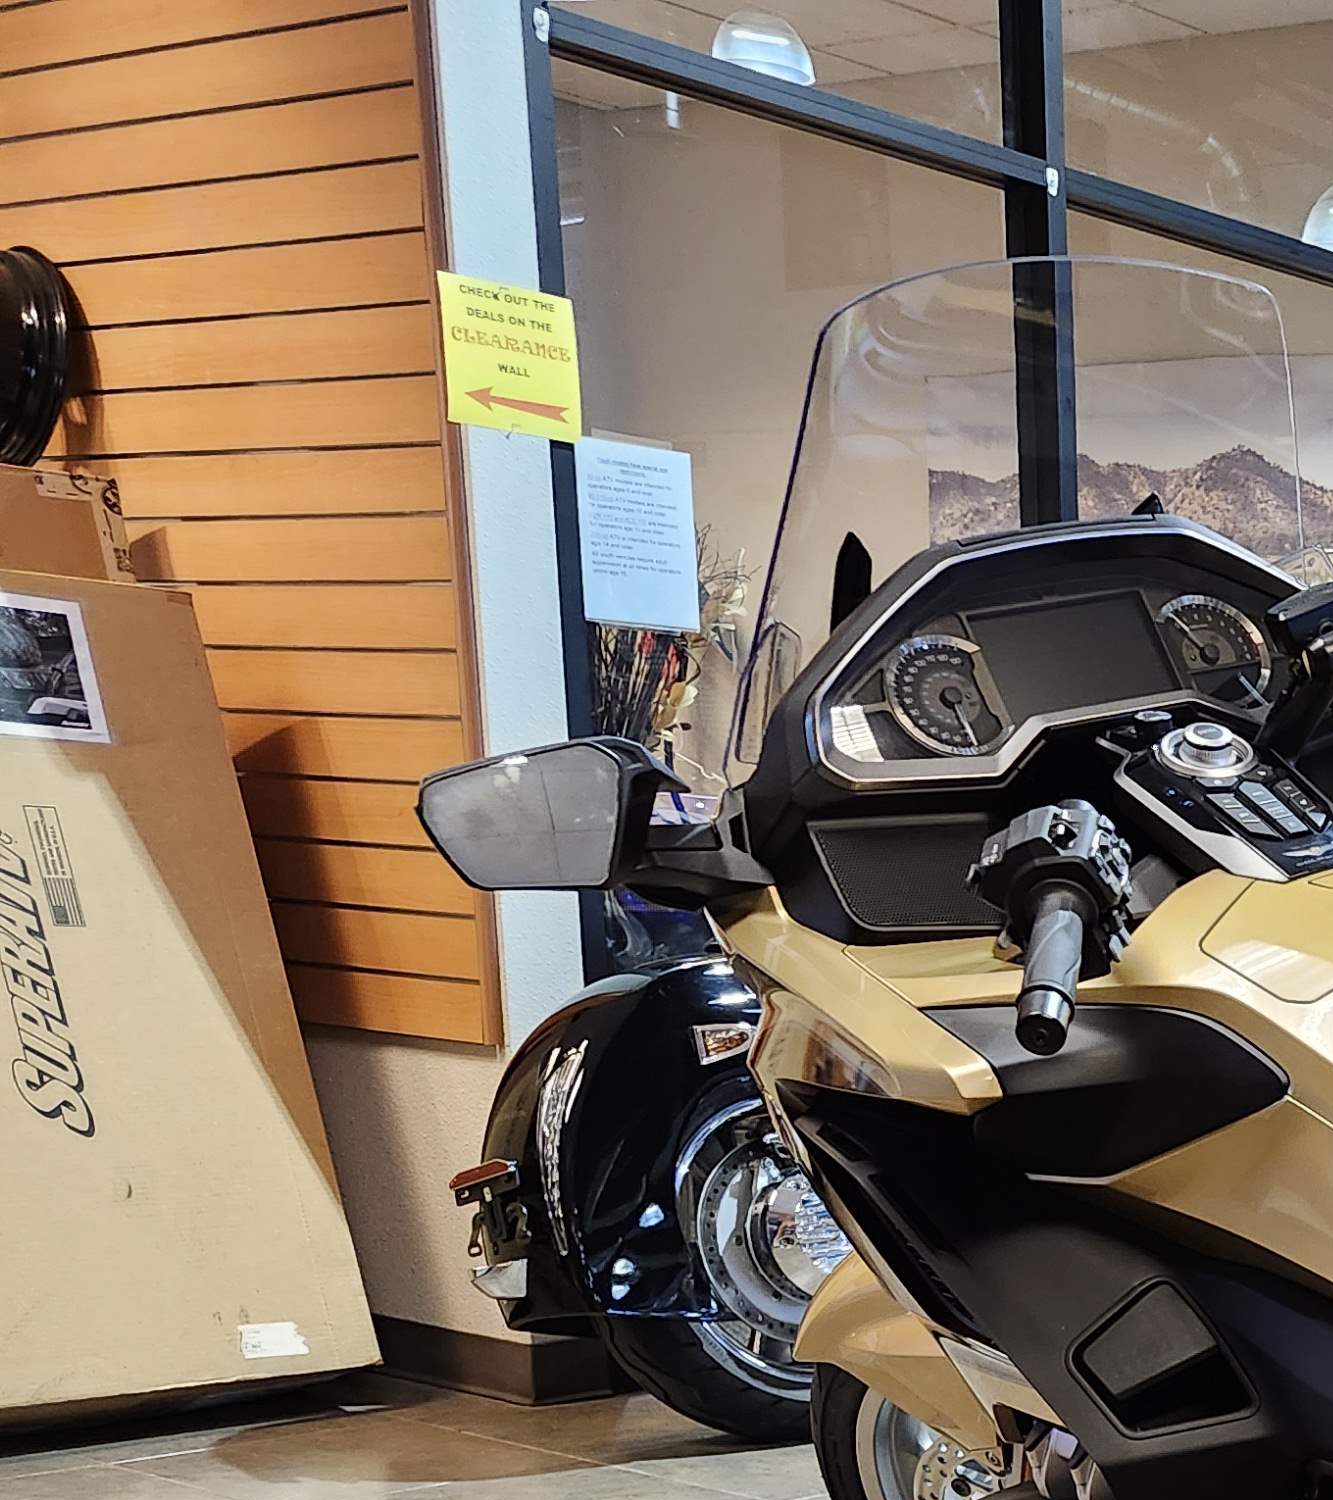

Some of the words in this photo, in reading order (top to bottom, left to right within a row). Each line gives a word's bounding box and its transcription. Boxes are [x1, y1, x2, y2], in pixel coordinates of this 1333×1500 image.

[459, 284, 500, 301] CHECK
[504, 294, 529, 307] OUT
[532, 300, 555, 313] THE
[466, 307, 505, 323] DEALS
[508, 316, 526, 327] ON
[530, 320, 553, 333] THE
[451, 325, 571, 363] CLEARANCE
[497, 363, 531, 378] WALL
